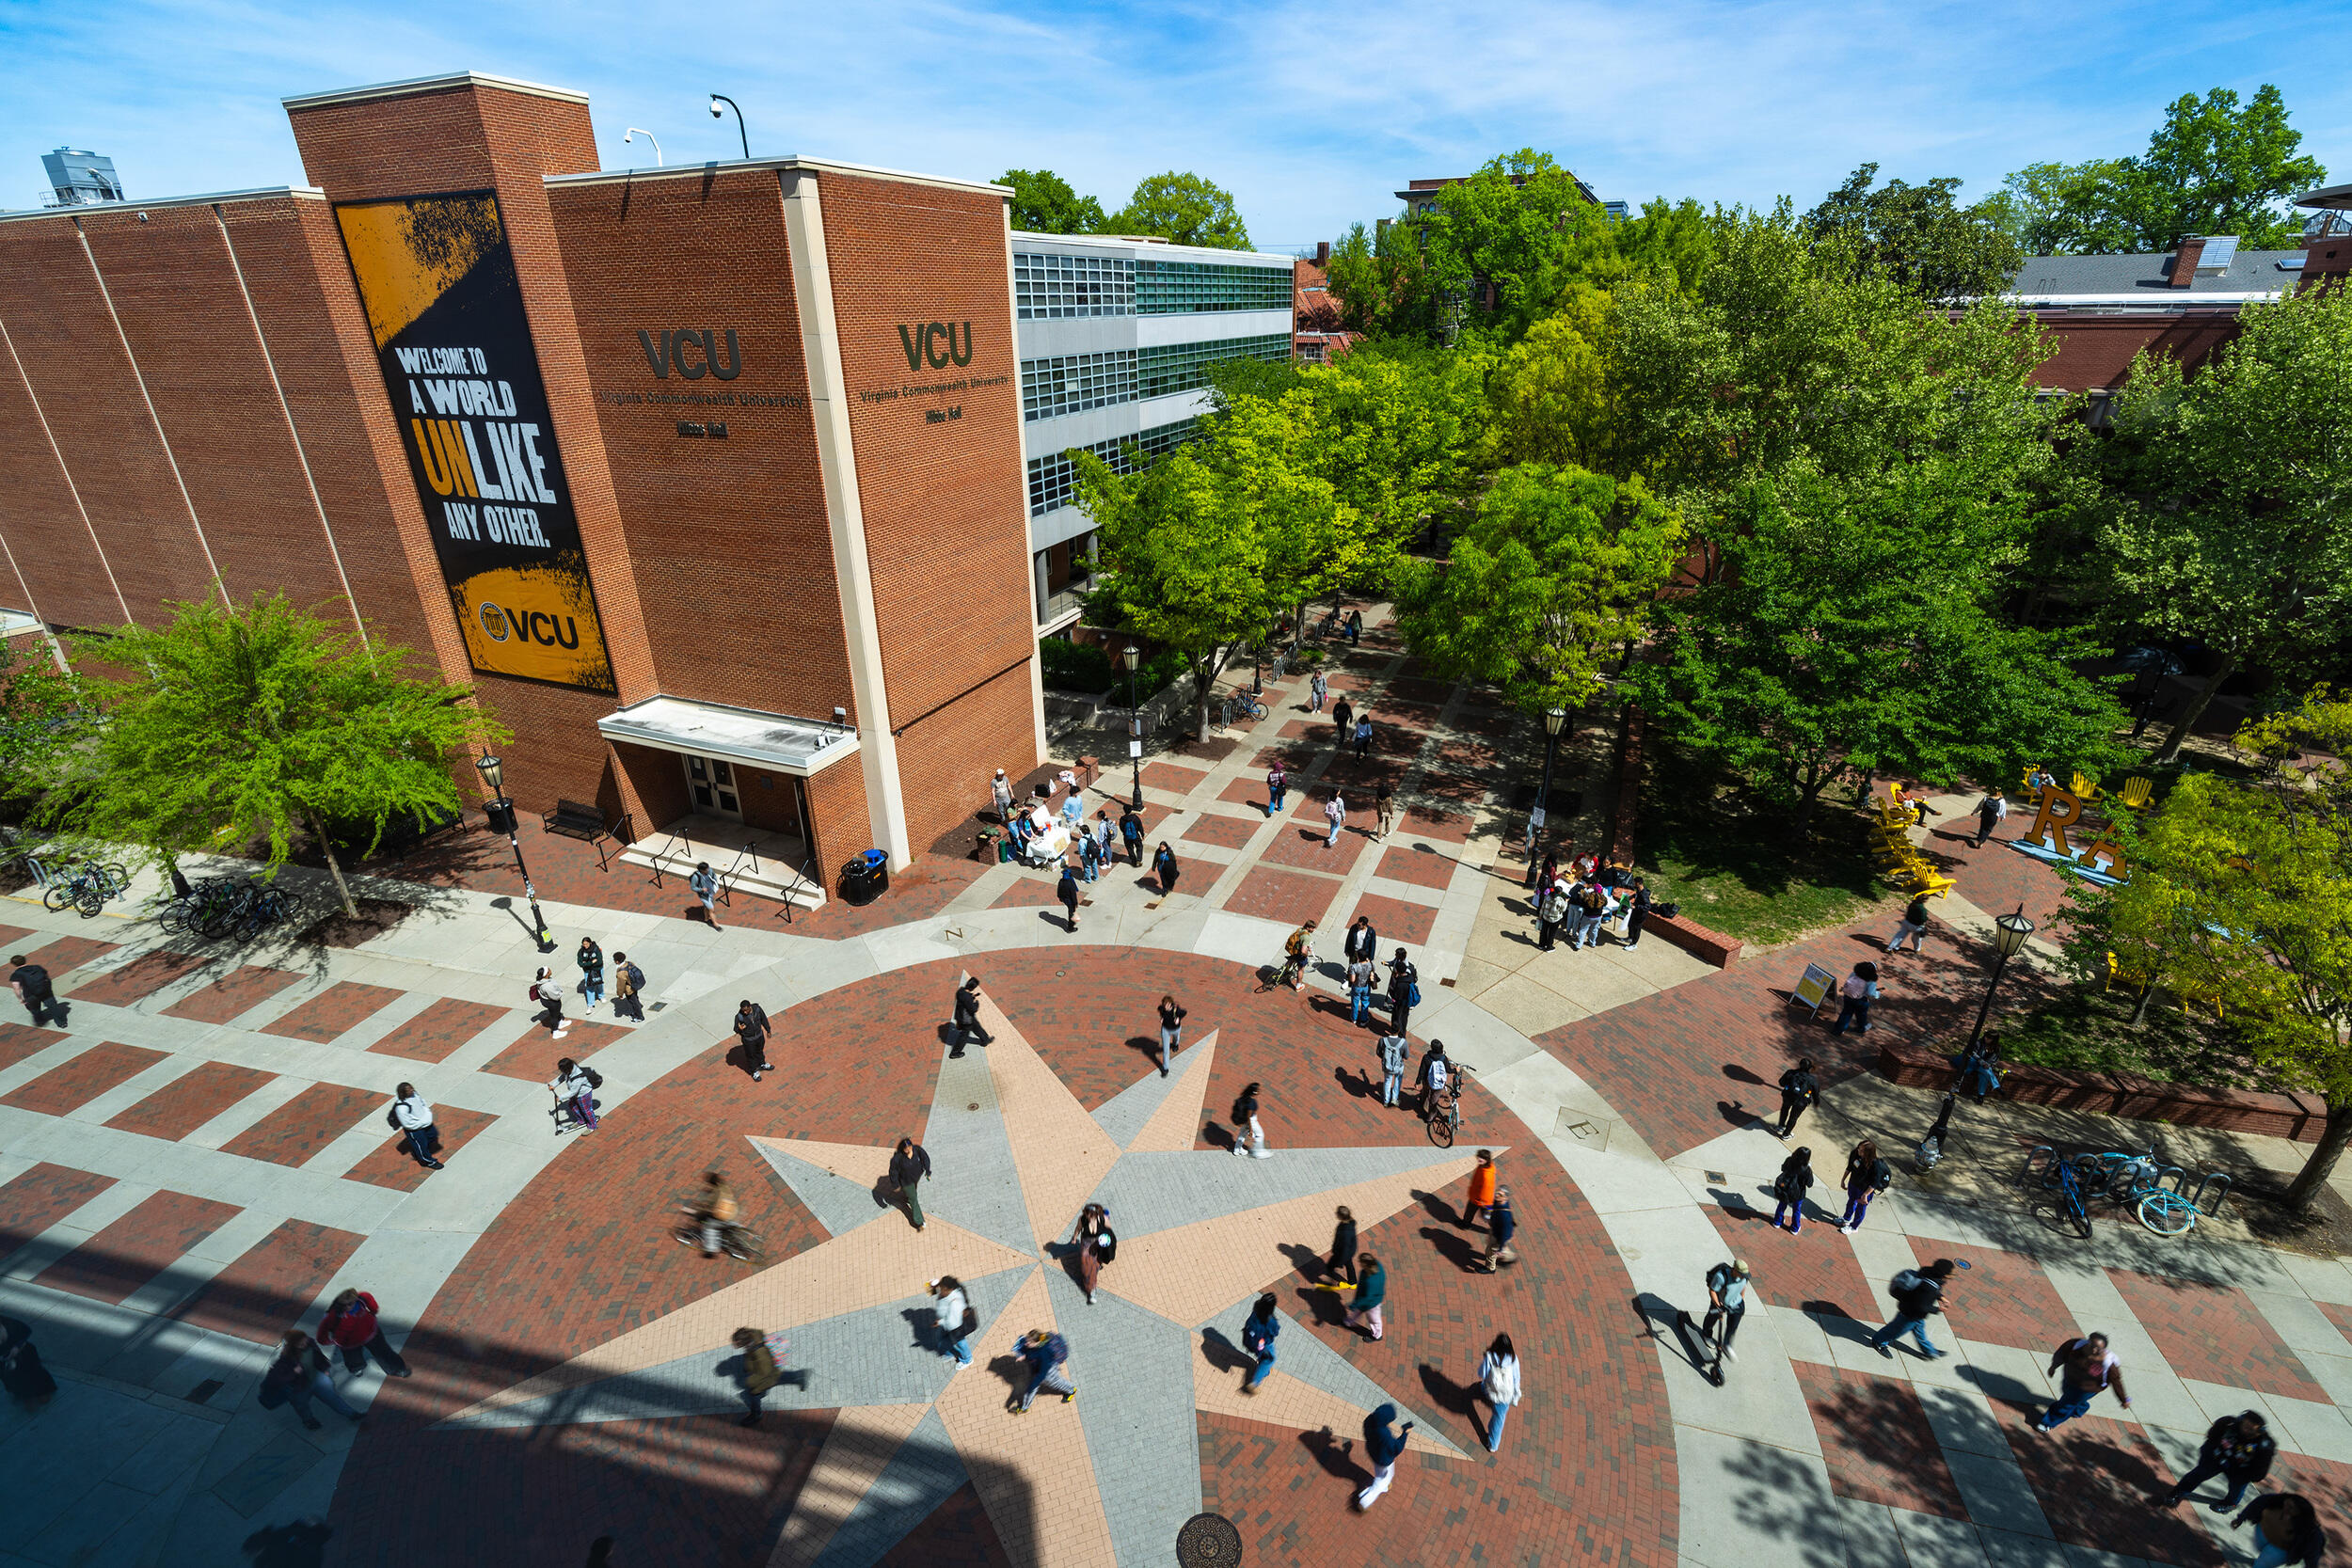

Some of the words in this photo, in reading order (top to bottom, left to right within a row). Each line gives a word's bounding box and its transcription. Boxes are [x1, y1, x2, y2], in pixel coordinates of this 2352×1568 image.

[394, 347, 470, 374] WELCOME
[467, 347, 488, 375] TO
[637, 328, 741, 380] VCU
[898, 322, 973, 372] VCU
[408, 378, 427, 414] A
[422, 378, 517, 417] WORLD
[600, 390, 643, 407] Virginia
[646, 391, 736, 406] Commonwealth
[740, 393, 803, 409] University
[860, 388, 898, 404] Virginia
[902, 378, 967, 398] Commonwealth
[970, 375, 1009, 389] University
[411, 419, 557, 504] UNLIKE
[443, 501, 481, 541] ANY
[483, 504, 551, 548] OTHER.
[504, 608, 579, 650] VCU
